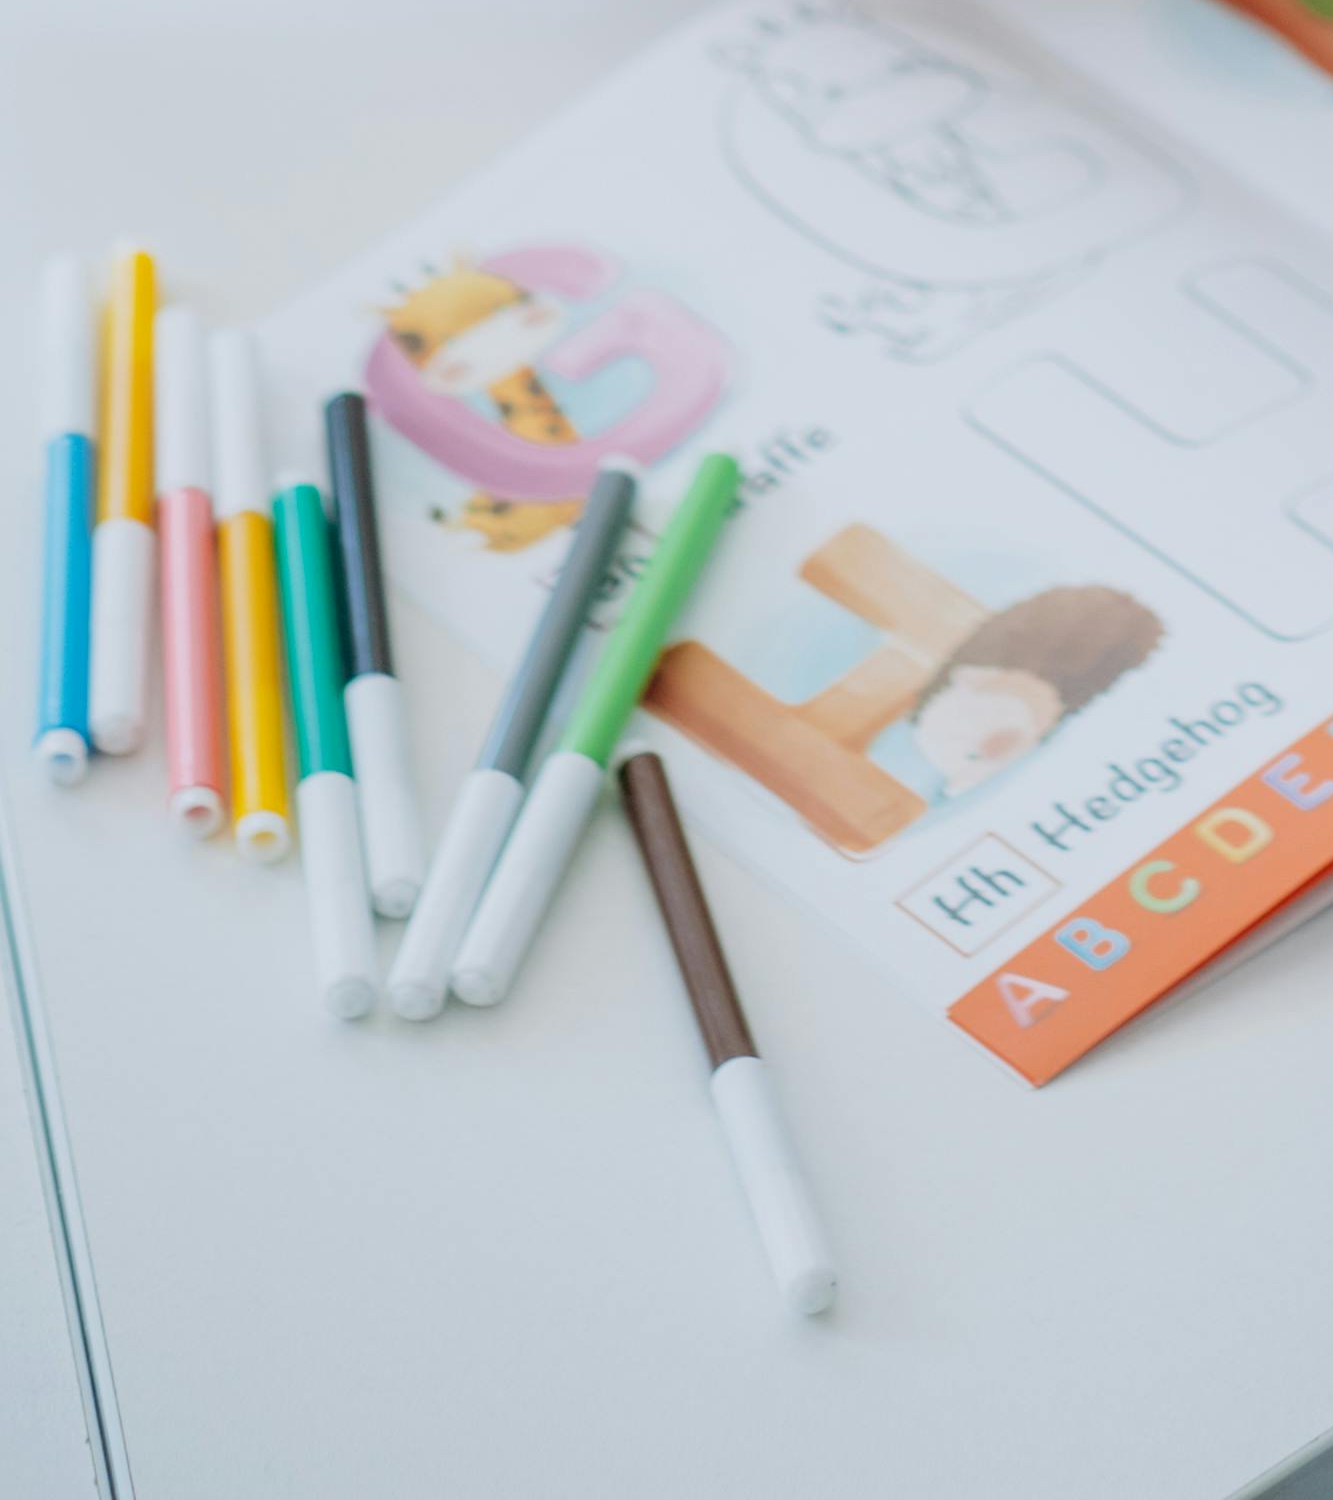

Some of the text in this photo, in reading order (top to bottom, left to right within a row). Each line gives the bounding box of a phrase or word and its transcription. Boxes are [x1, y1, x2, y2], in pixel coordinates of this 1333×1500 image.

[931, 680, 1286, 928] Hh Hedgehog
[994, 971, 1072, 1031] A
[1052, 914, 1133, 973] B
[1127, 857, 1202, 914] C
[1193, 805, 1275, 865] D
